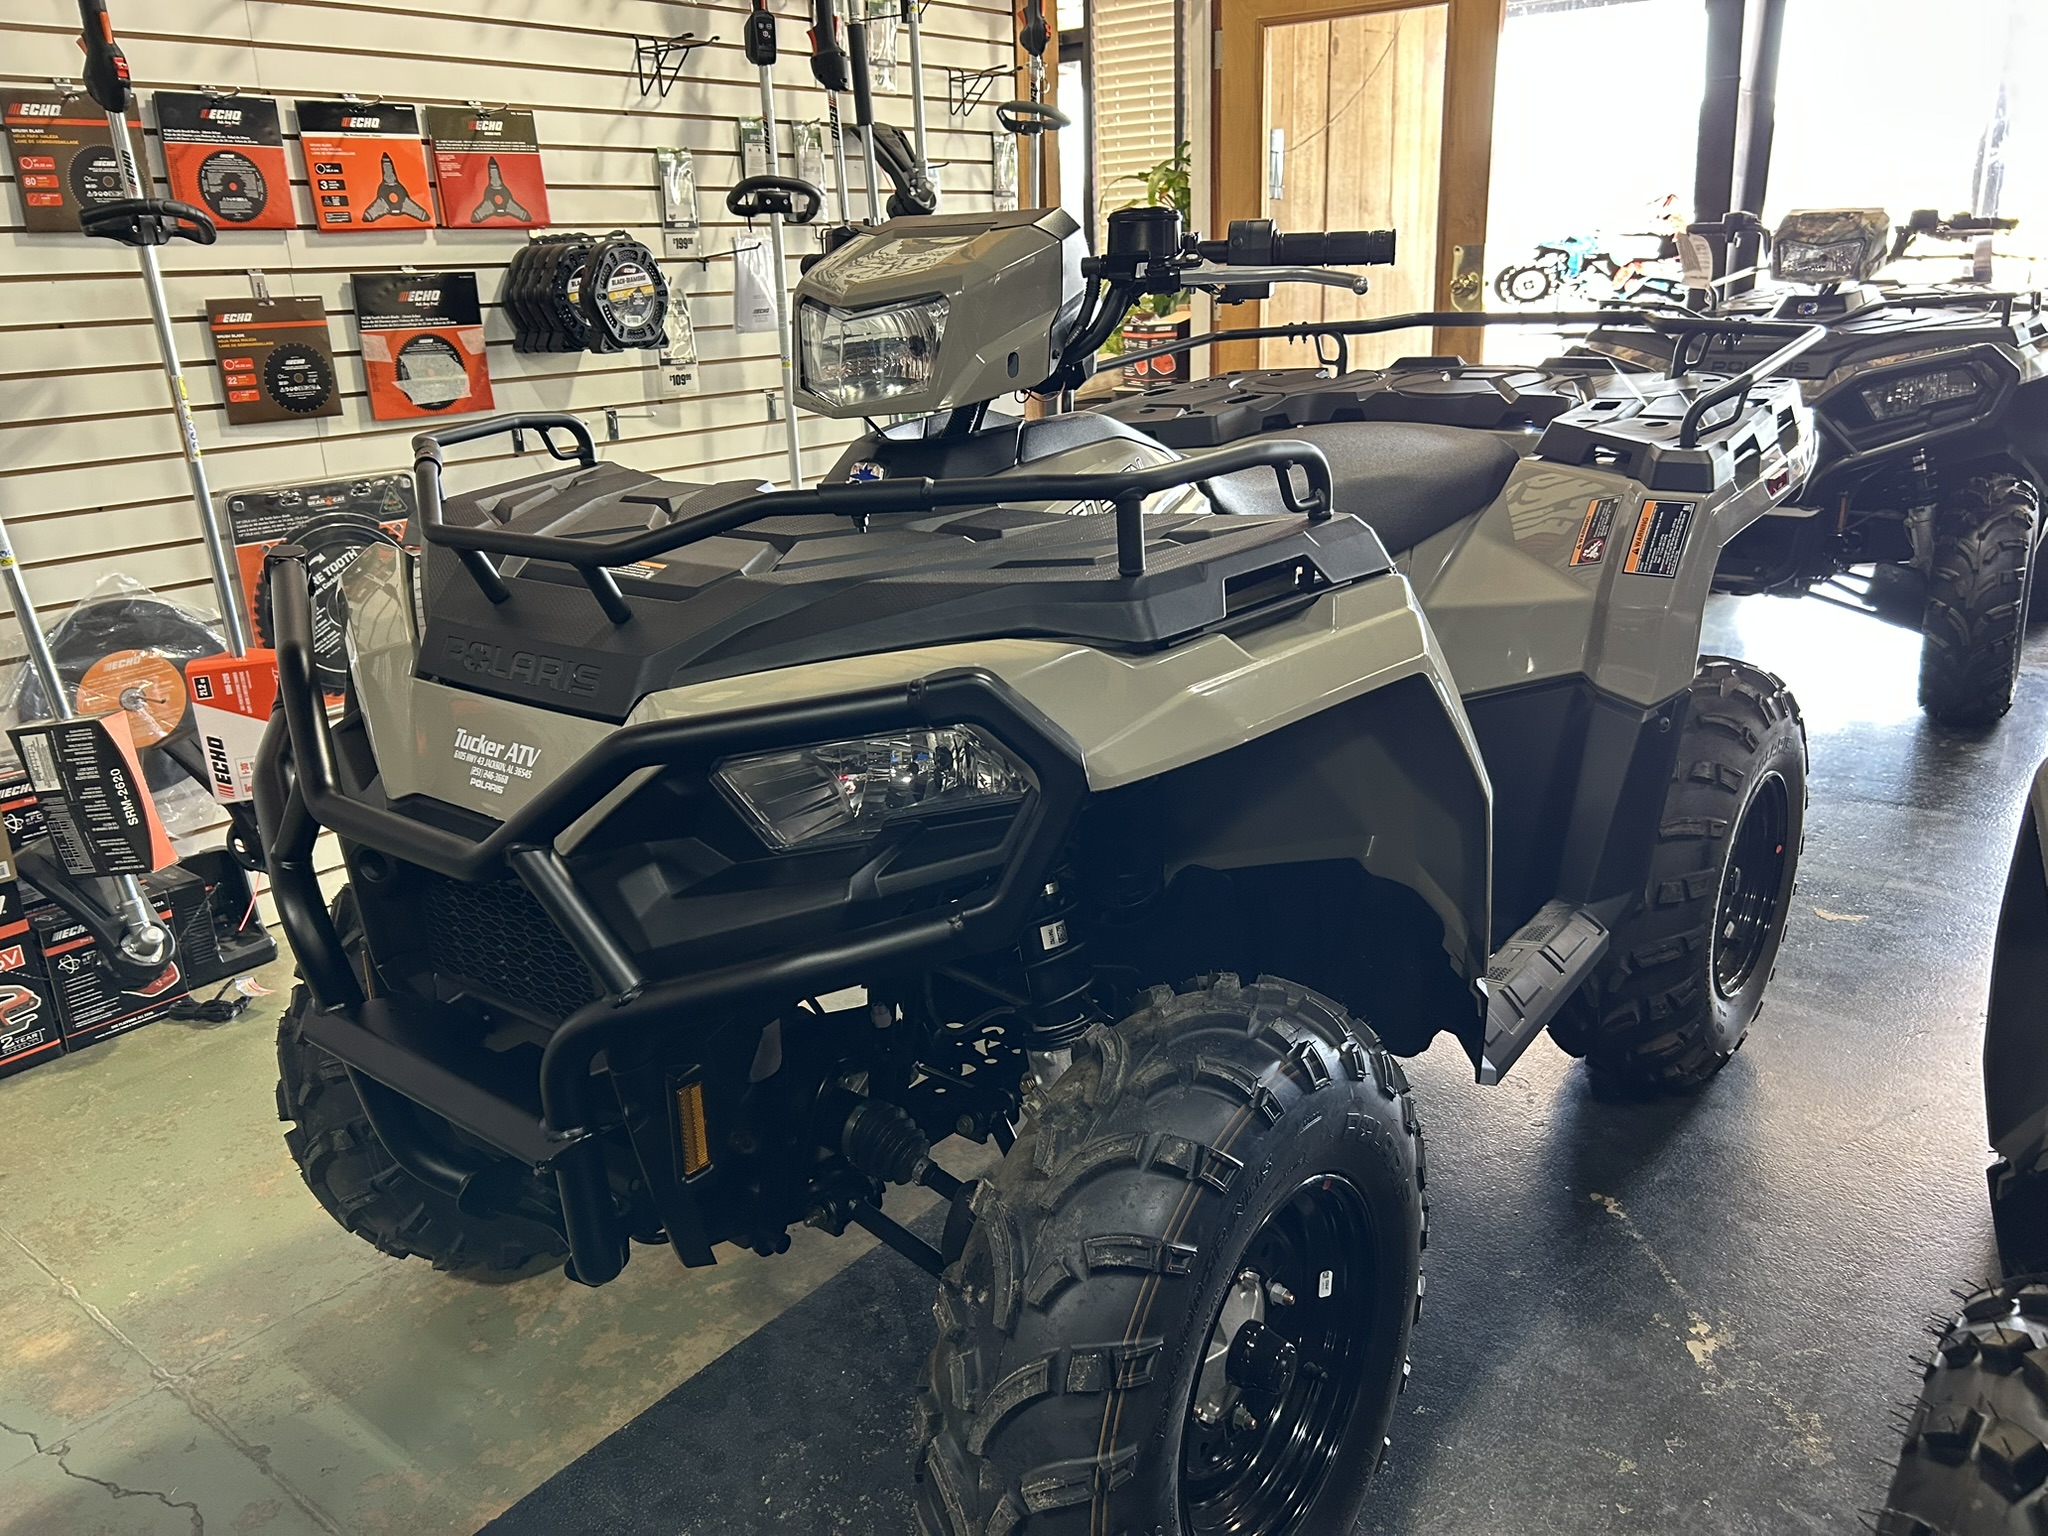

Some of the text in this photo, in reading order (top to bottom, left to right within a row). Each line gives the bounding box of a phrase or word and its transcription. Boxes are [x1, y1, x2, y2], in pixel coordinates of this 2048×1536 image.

[20, 103, 62, 116] ECHO
[209, 109, 242, 120] ECHO
[349, 117, 380, 128] ECHO
[475, 121, 503, 131] ECHO
[829, 105, 840, 141] ECHO
[121, 149, 137, 185] ECHO
[25, 177, 37, 186] 80
[320, 180, 328, 190] 3
[408, 290, 441, 302] ECHO
[222, 313, 253, 323] ECHO
[1711, 361, 1810, 373] POLIS
[227, 377, 238, 385] 22
[322, 548, 358, 577] TOOTH
[111, 655, 142, 670] ECHO
[443, 636, 602, 699] POLARIS
[454, 727, 542, 768] Tucker ATV
[206, 735, 233, 785] ECHO
[4, 783, 33, 799] ECH
[469, 777, 505, 795] POLARIS
[110, 768, 139, 827] SRM-2620
[59, 924, 87, 941] ECH
[14, 1032, 39, 1044] YEAR
